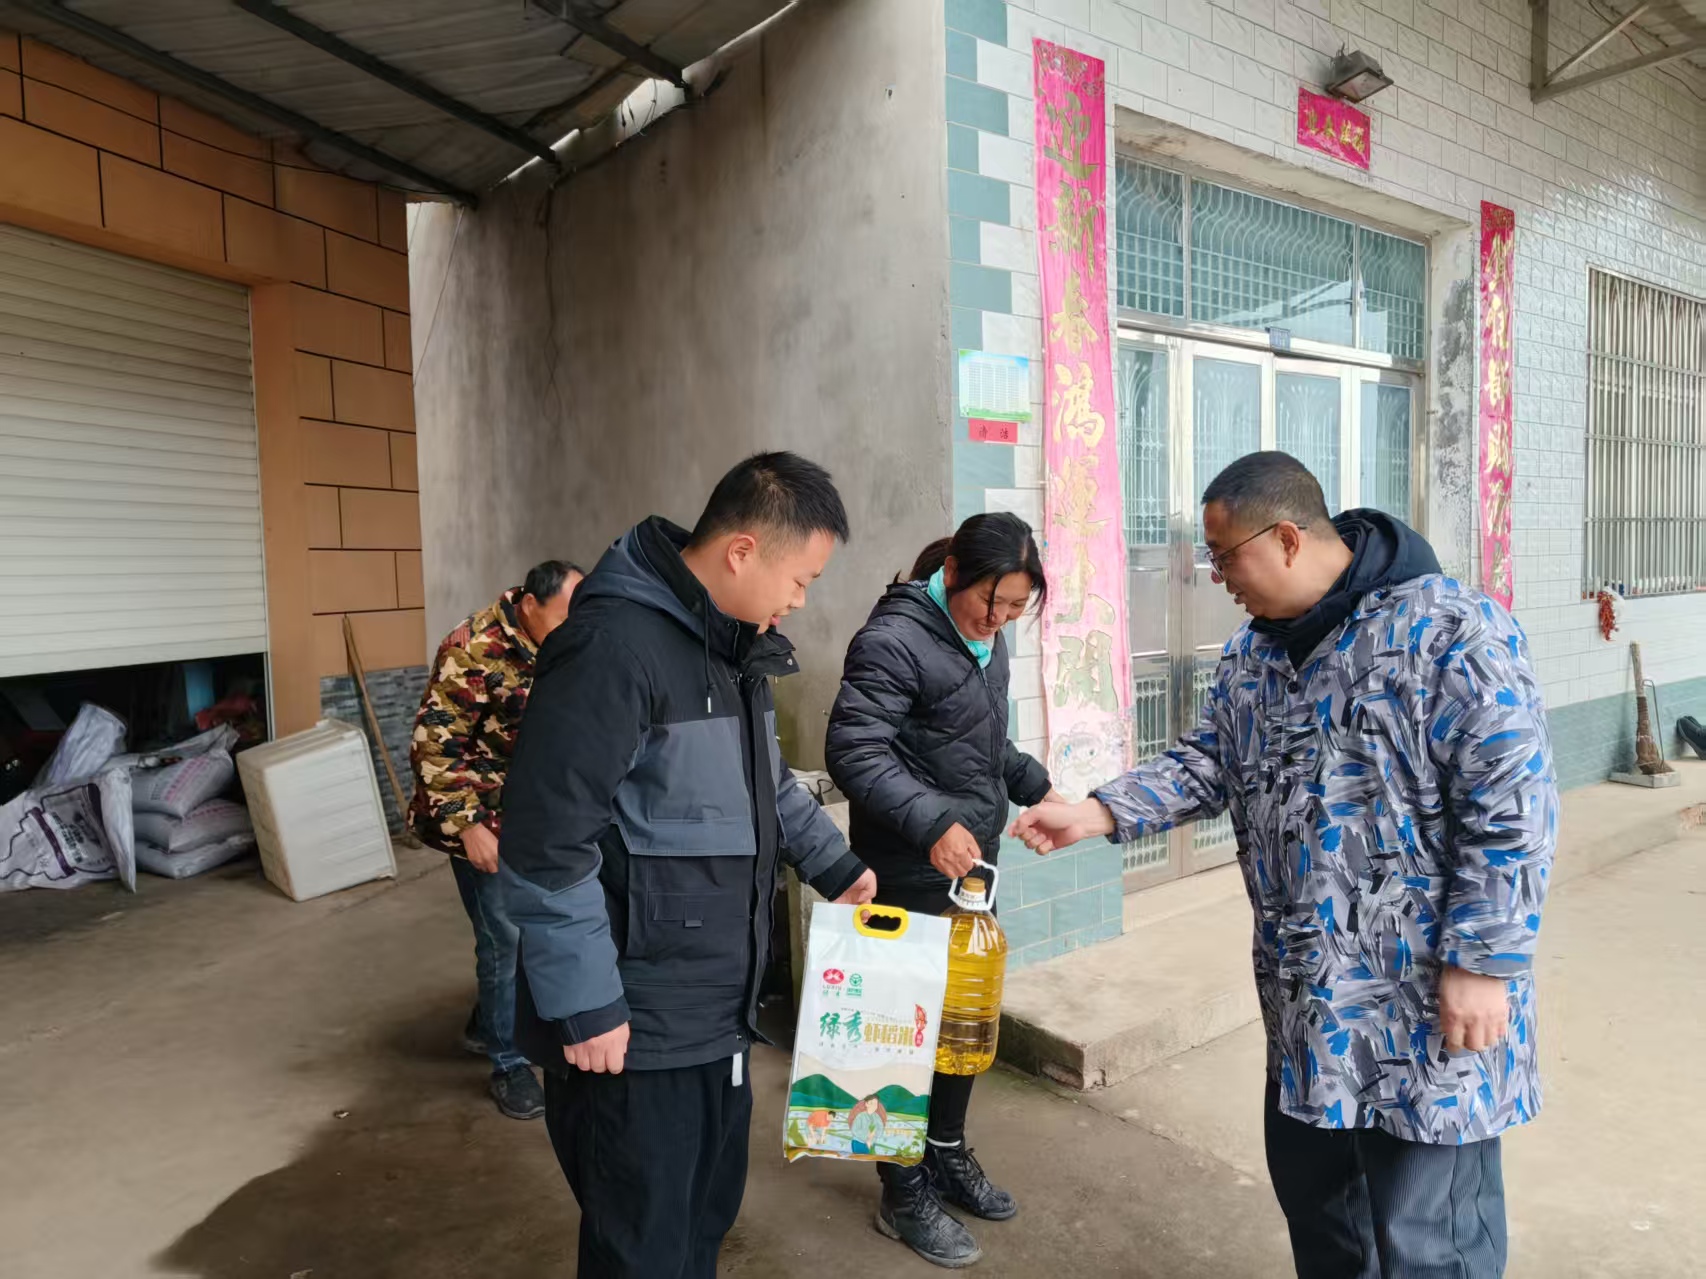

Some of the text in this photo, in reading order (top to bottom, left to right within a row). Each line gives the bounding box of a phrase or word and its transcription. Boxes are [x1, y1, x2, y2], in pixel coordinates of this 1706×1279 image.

[819, 1010, 862, 1043] 绿秀
[864, 1023, 914, 1046] 虾稻米
